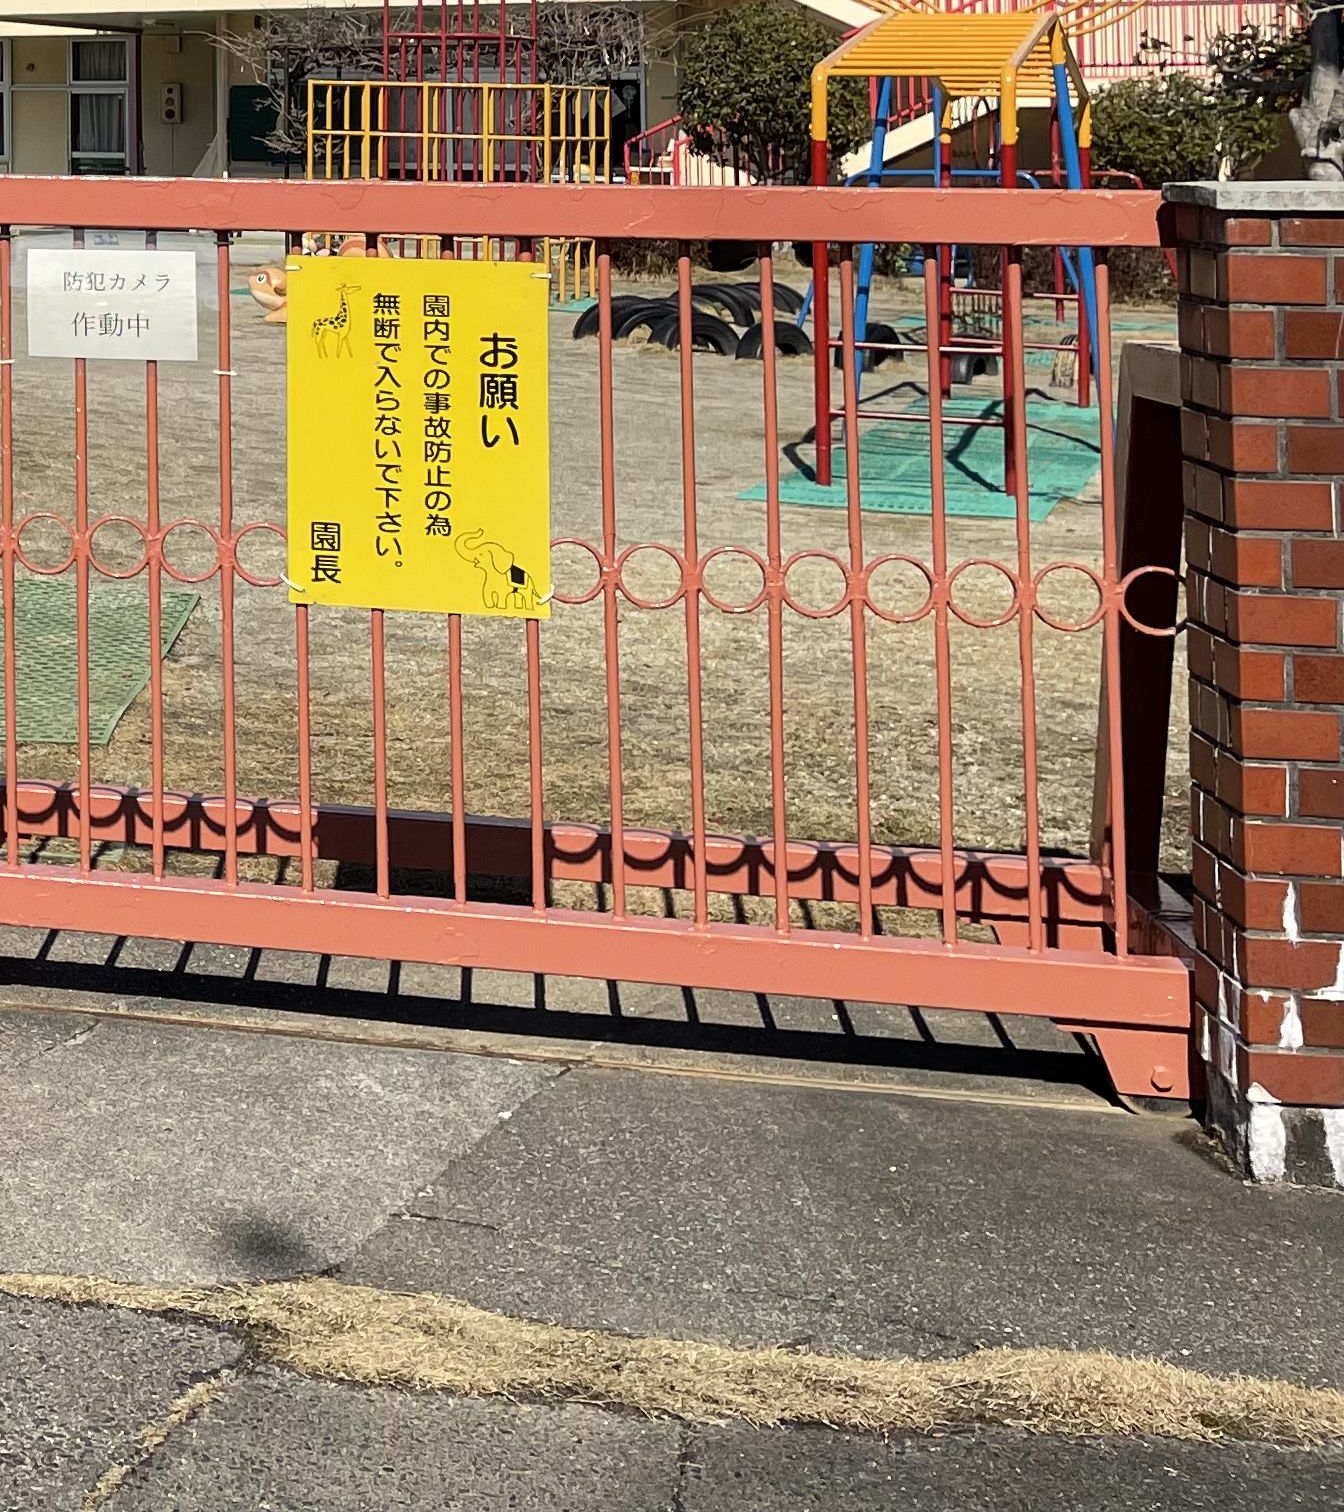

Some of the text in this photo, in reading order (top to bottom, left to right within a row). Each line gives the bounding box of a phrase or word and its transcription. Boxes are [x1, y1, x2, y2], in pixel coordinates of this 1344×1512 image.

[63, 271, 171, 292] 防犯カメラ
[71, 312, 150, 338] 作動中
[373, 292, 402, 569] 無断で入らないで下さい。
[422, 294, 452, 538] 園内での事故防止の為
[479, 332, 520, 449] お願い
[311, 521, 342, 584] 園長
